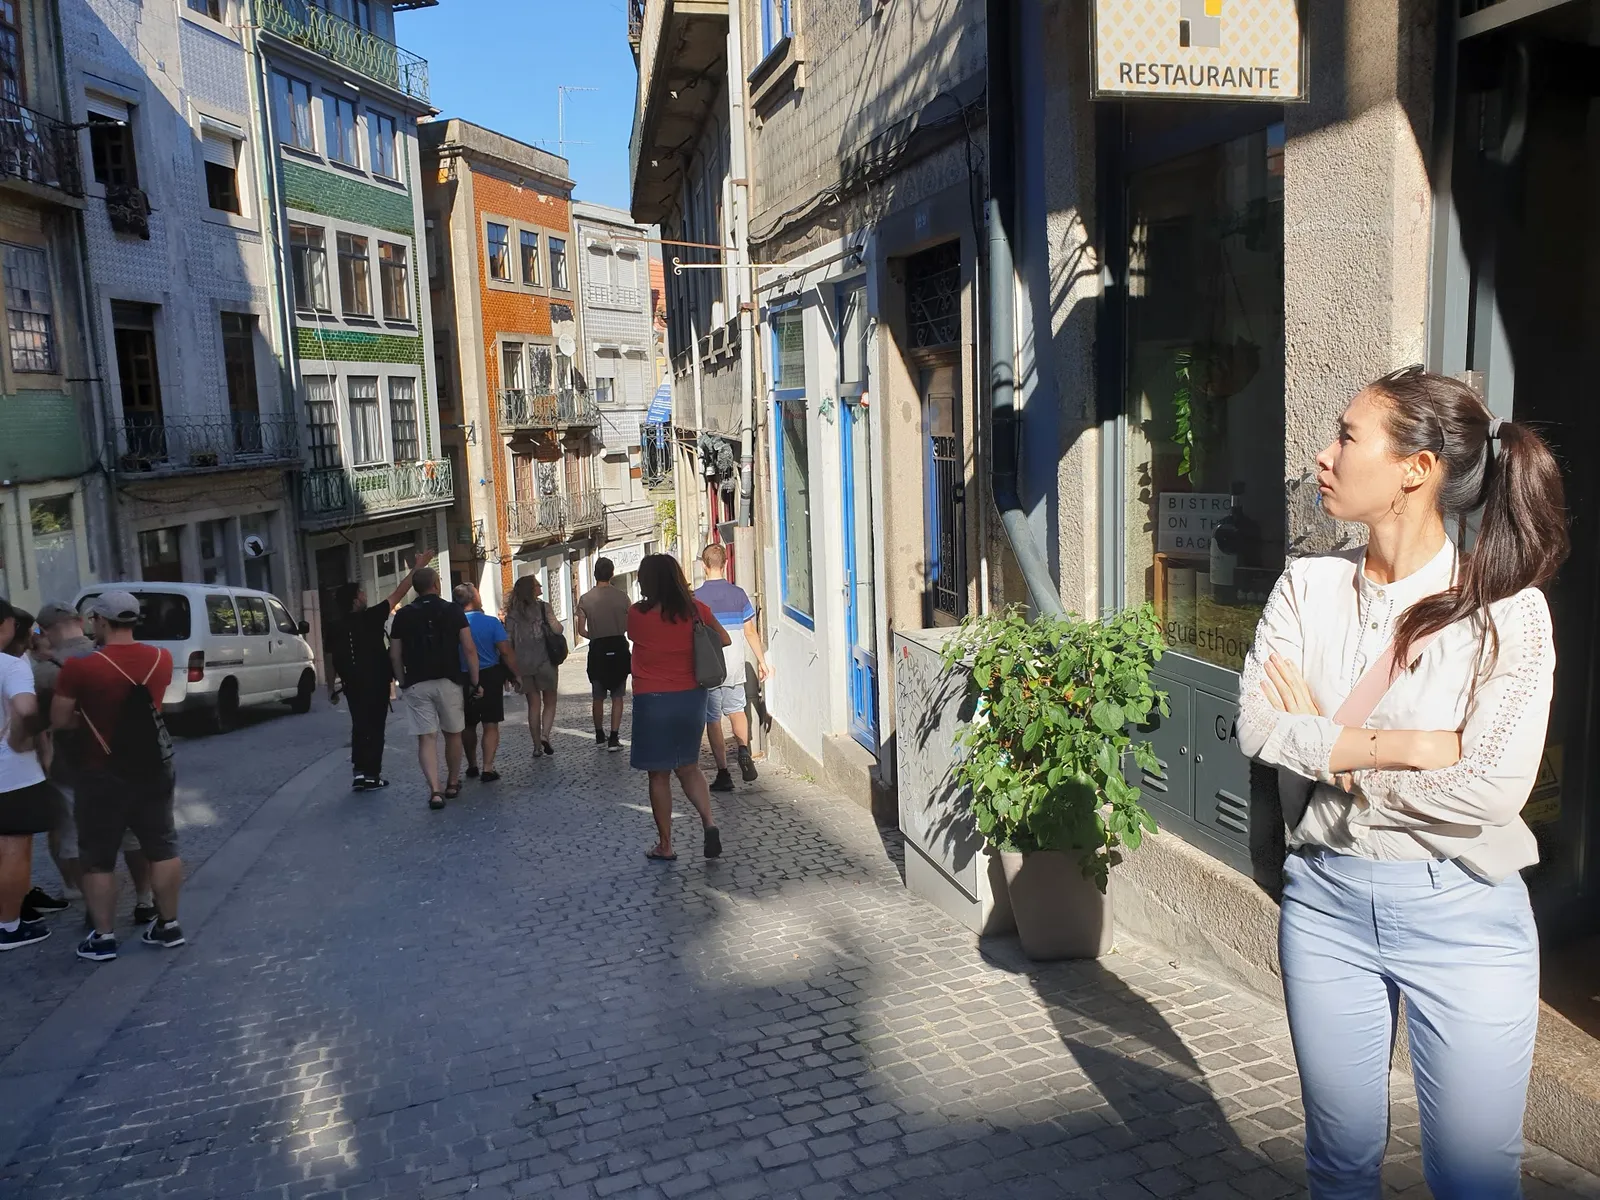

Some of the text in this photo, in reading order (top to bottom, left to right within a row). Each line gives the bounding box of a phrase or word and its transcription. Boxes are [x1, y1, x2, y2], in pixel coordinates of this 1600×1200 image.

[1118, 62, 1279, 89] RESTAURANTE
[1168, 497, 1232, 510] BISTRO
[1168, 516, 1188, 529] ON
